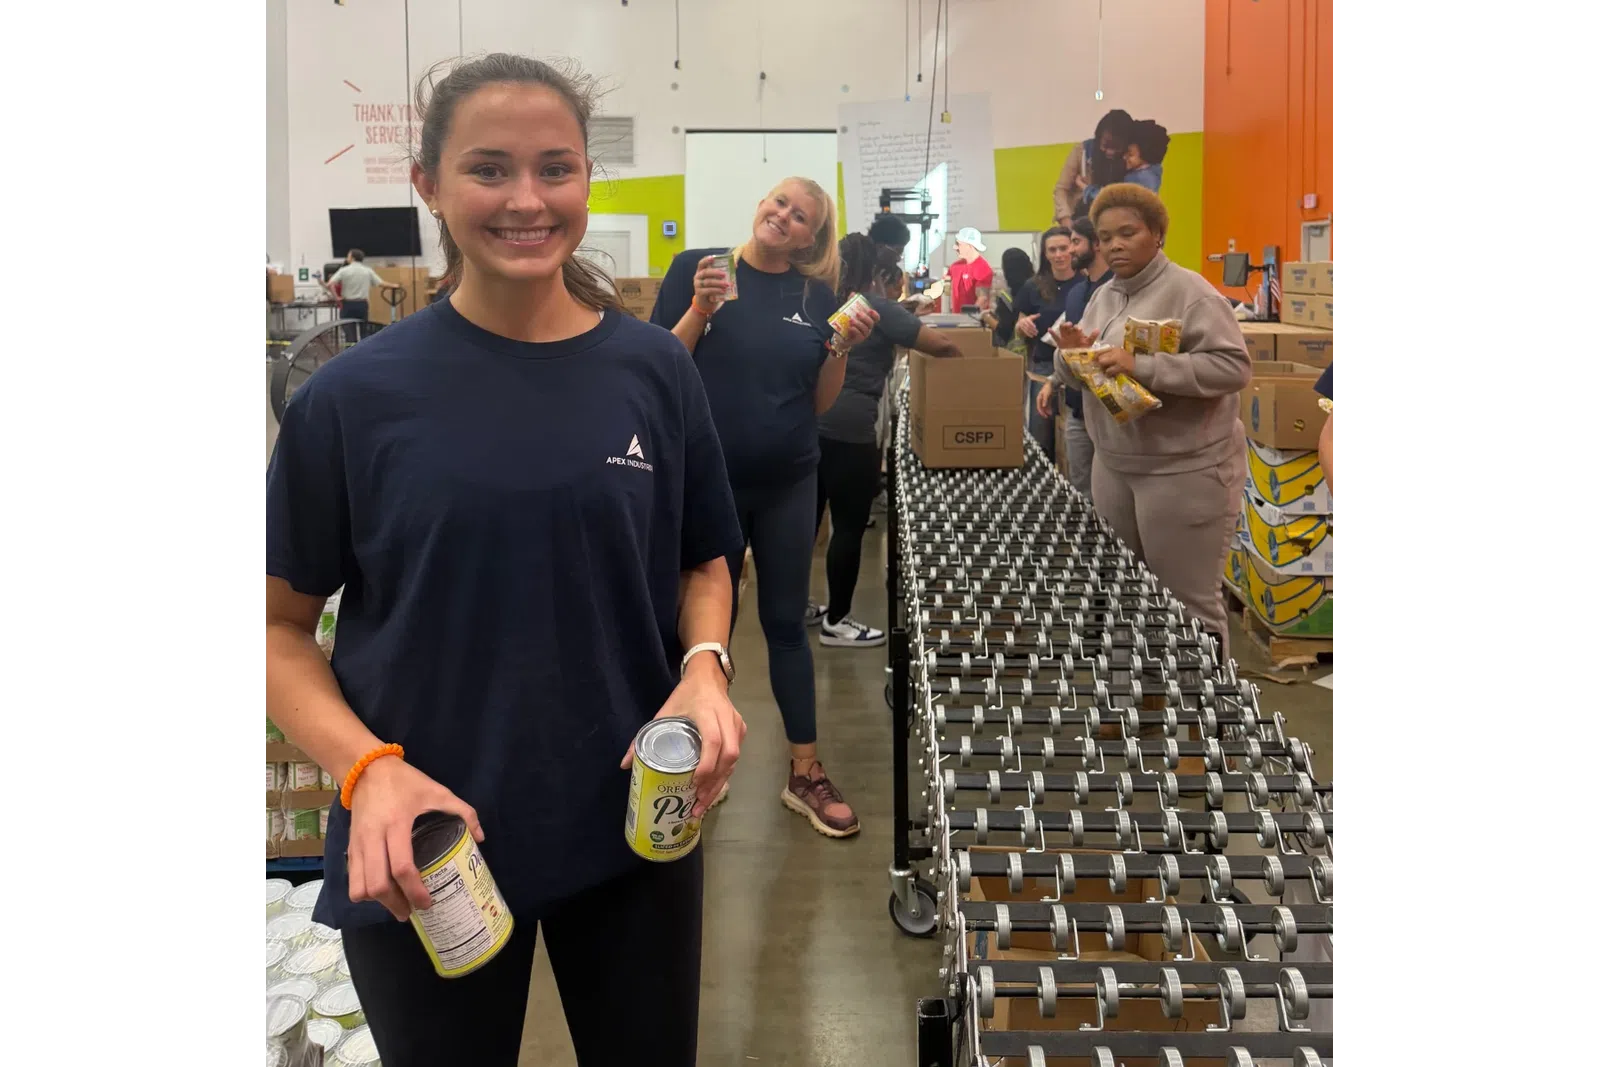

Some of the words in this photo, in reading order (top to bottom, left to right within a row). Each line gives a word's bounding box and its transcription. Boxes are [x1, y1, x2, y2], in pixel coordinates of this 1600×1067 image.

[354, 104, 394, 122] THANK
[366, 126, 404, 144] SERVE
[955, 431, 994, 444] CSFP
[606, 456, 626, 466] APEX
[430, 867, 448, 880] Facts
[454, 878, 464, 889] 70
